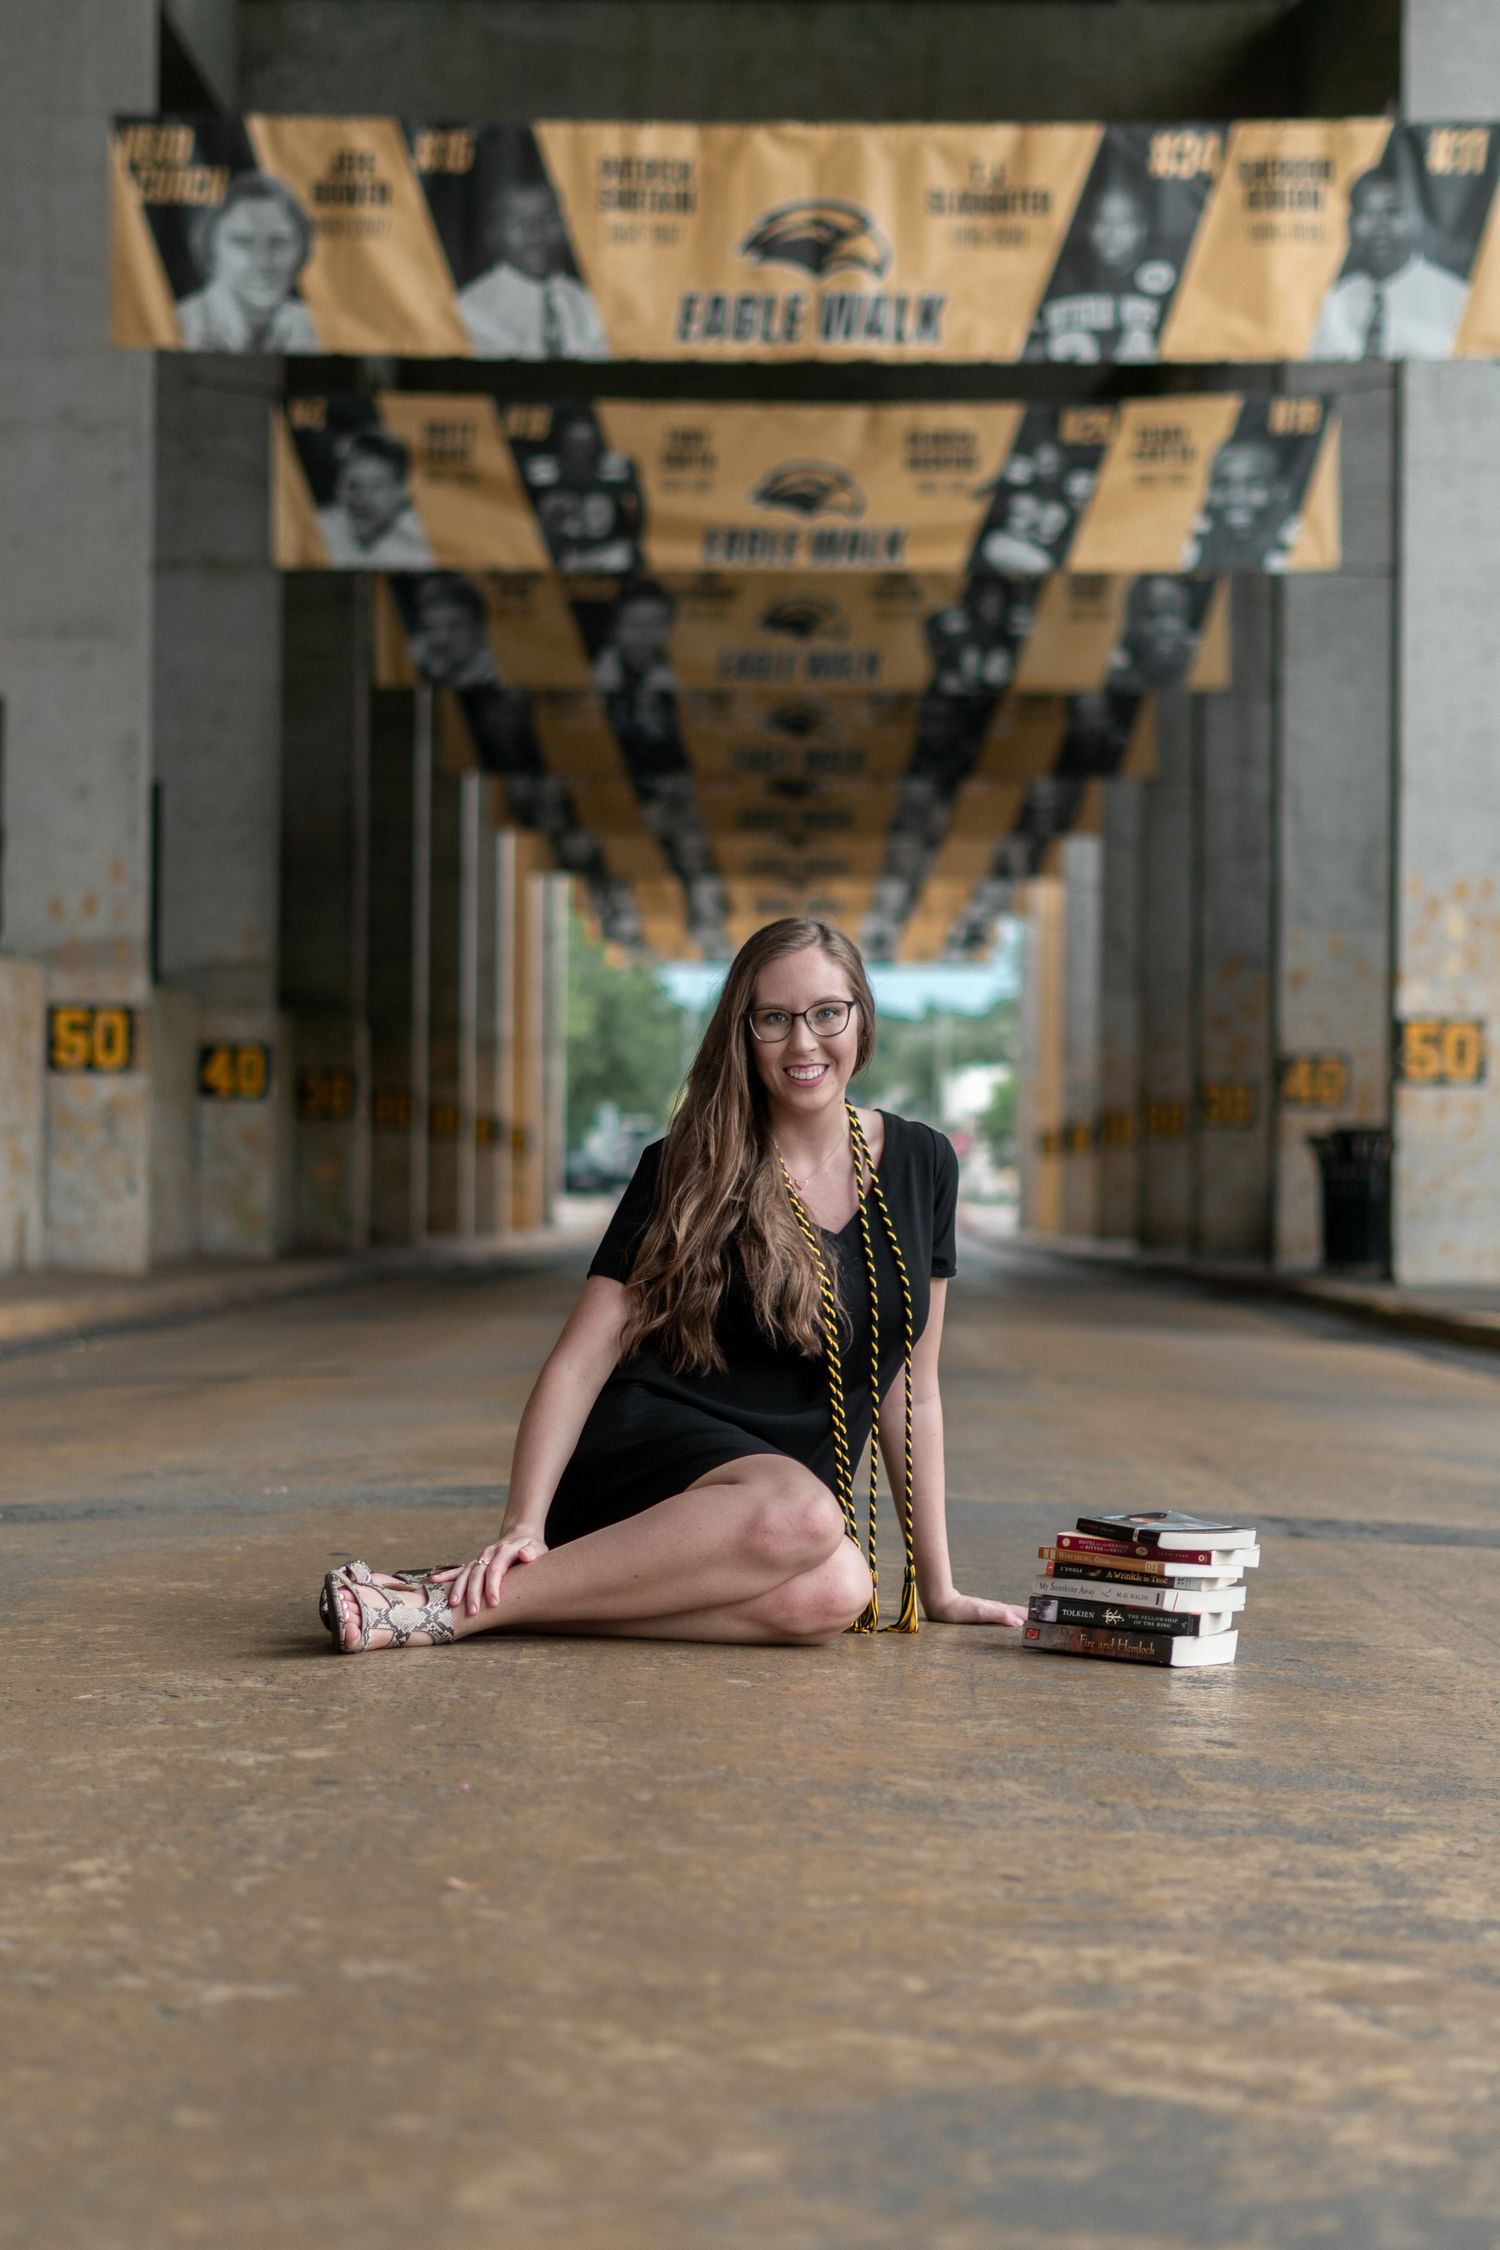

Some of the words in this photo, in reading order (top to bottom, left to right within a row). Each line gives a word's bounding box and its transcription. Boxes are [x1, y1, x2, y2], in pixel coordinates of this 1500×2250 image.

[677, 291, 808, 344] EAGLE
[815, 292, 947, 344] WALK
[51, 1008, 131, 1068] 50
[1403, 1020, 1483, 1082] 50
[201, 1046, 268, 1098] 40
[1281, 1055, 1348, 1102] 40
[1039, 1582, 1048, 1592] My
[1050, 1582, 1077, 1594] Sunshine
[1078, 1586, 1096, 1597] Away
[1114, 1571, 1142, 1582] Wrinkle
[1062, 1609, 1095, 1618] TOLKIEN
[1141, 1615, 1178, 1623] FELLOWSHIP
[1080, 1634, 1096, 1648] Fire
[1098, 1638, 1114, 1650] and
[1117, 1639, 1155, 1655] Hemlock
